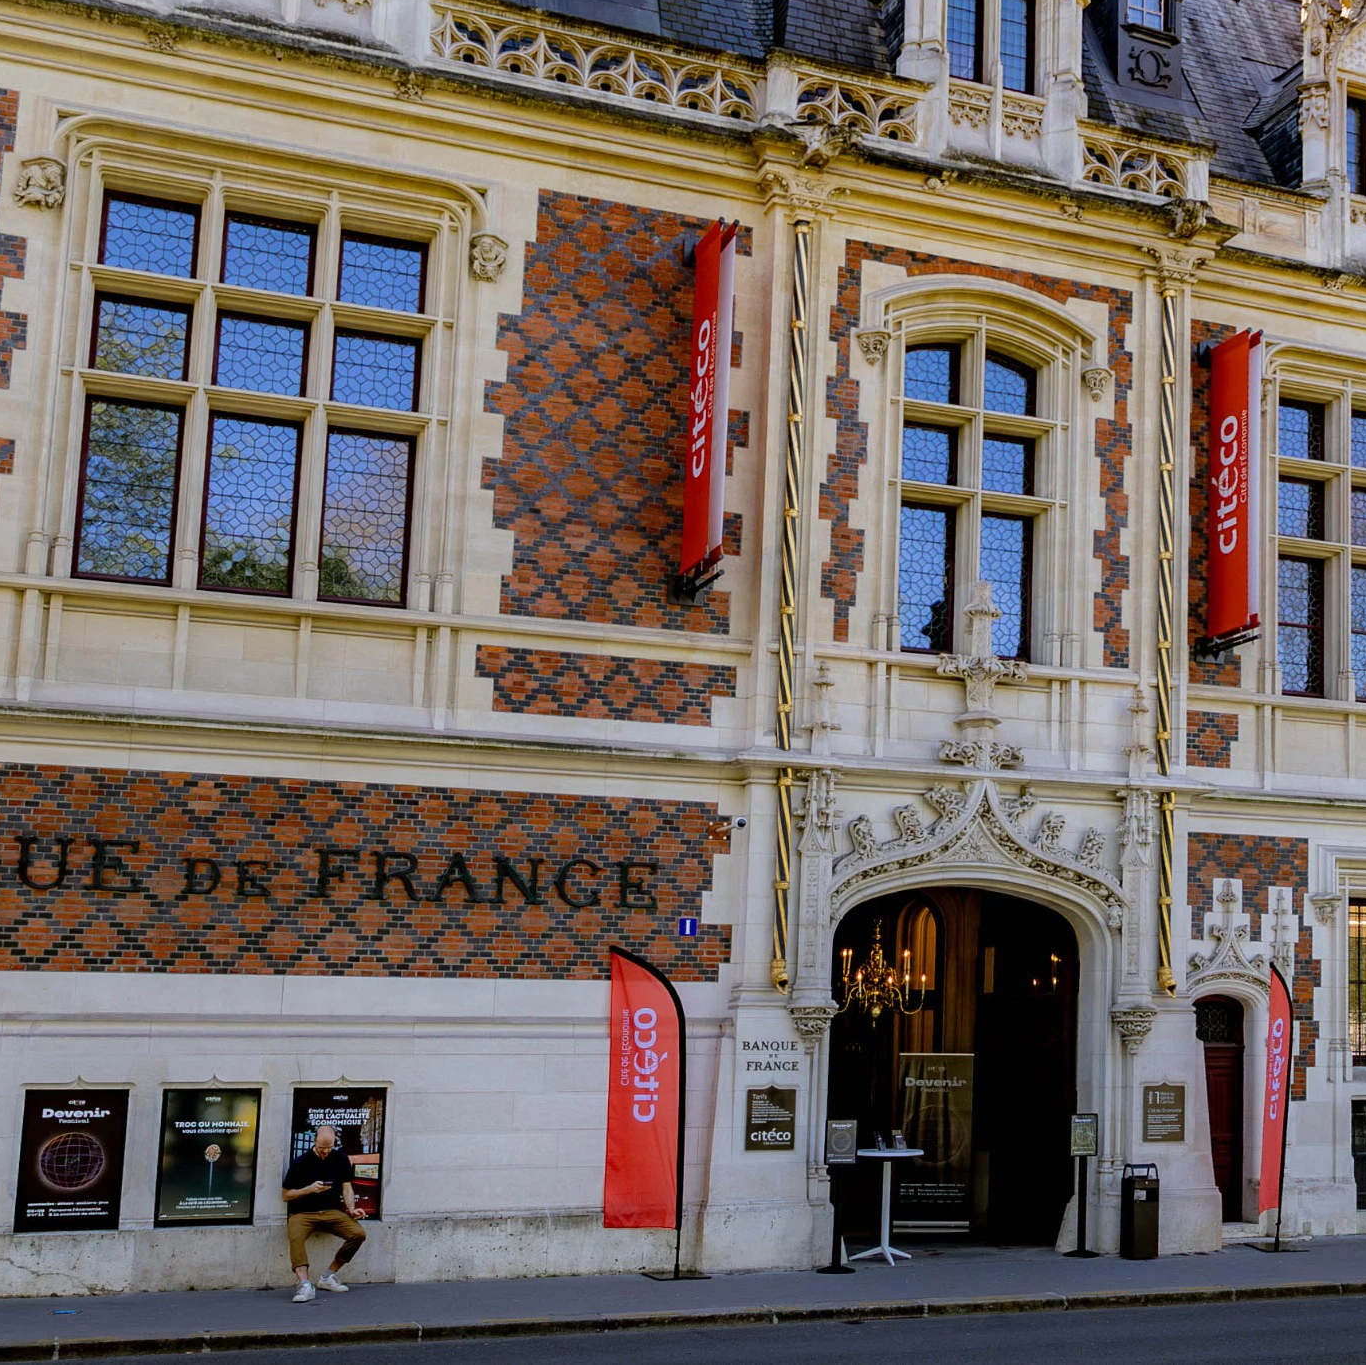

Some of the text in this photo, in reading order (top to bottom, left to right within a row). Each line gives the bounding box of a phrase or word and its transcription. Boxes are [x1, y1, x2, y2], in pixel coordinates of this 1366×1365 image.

[691, 319, 711, 478] citéco
[1239, 410, 1248, 504] Cité de l'Économie
[1211, 415, 1238, 555] citéco
[181, 857, 271, 896] DE
[309, 848, 658, 909] FRANCE
[742, 1041, 798, 1051] BANQUE
[746, 1061, 799, 1071] FRANCE
[905, 1077, 967, 1087] Devenir
[42, 1107, 110, 1118] Devenir
[750, 1128, 791, 1141] citéco
